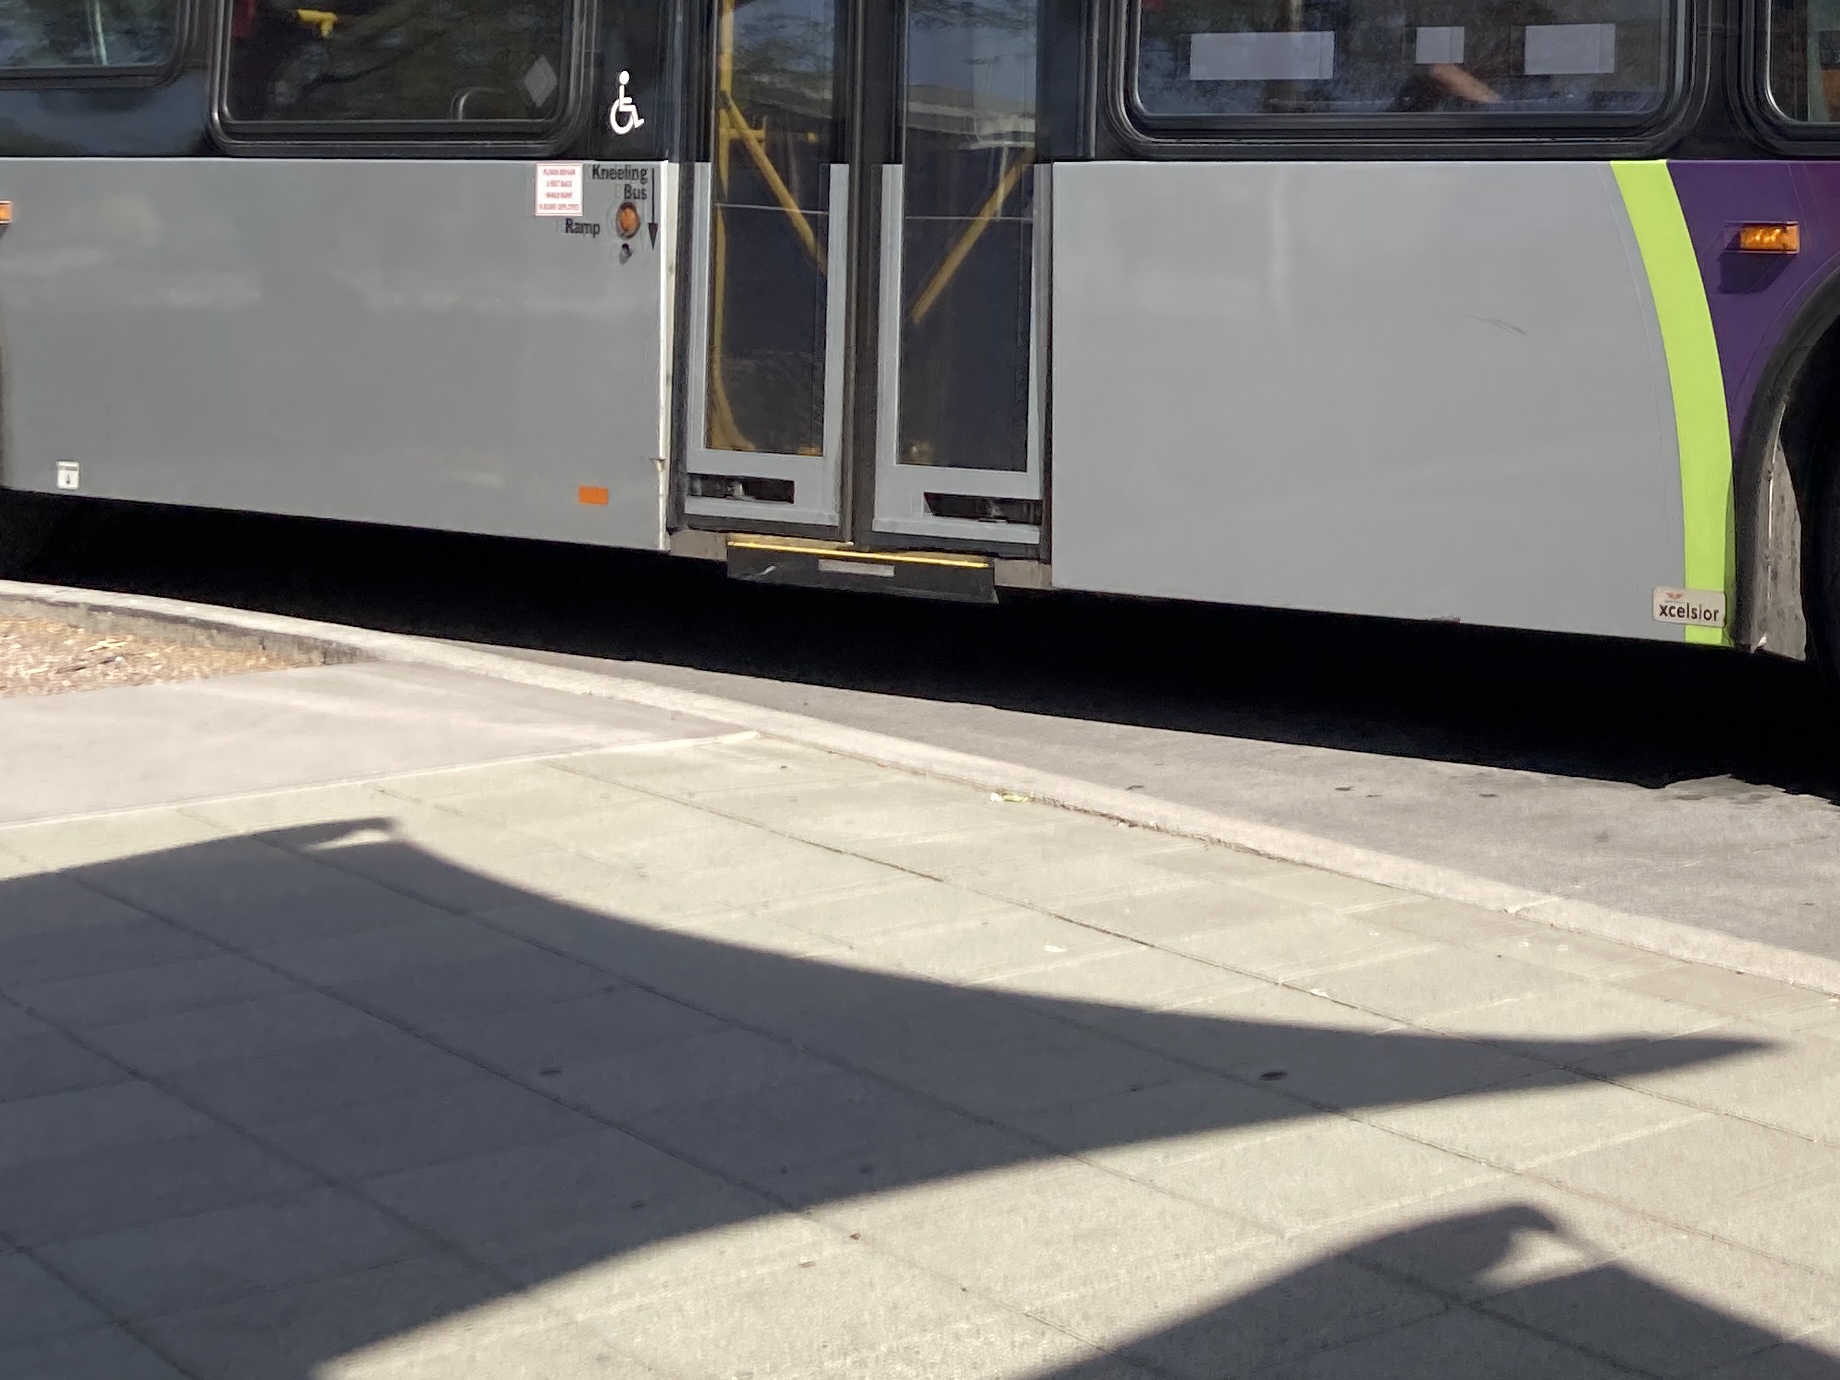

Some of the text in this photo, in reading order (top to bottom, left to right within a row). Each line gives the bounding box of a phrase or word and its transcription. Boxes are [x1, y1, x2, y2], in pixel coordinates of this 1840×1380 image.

[592, 164, 648, 185] Kneeling
[623, 184, 647, 200] Bus
[565, 218, 600, 237] Ramp
[1659, 602, 1719, 622] xcelsior
